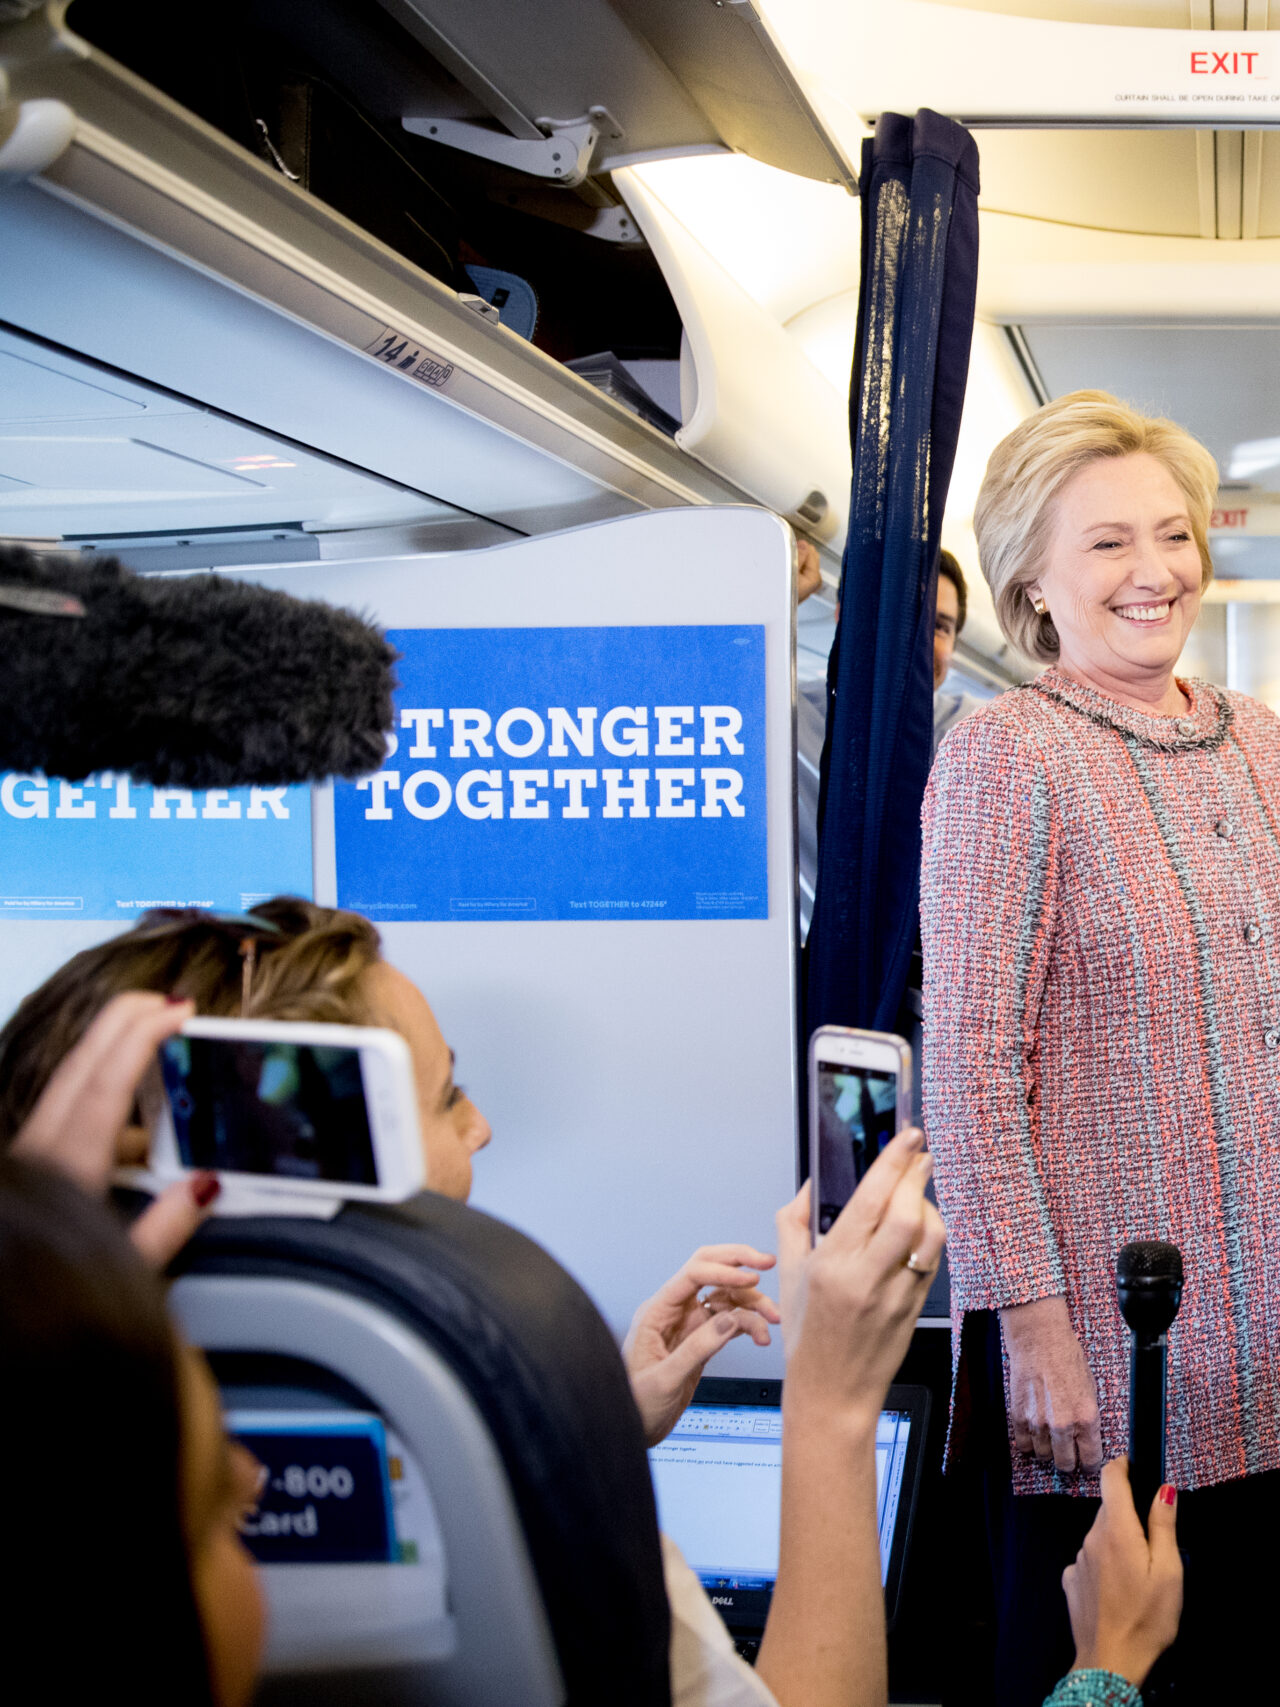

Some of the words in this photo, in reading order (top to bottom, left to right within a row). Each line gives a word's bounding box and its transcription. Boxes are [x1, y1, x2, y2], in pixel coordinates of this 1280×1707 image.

[1190, 51, 1260, 75] EXIT
[1114, 94, 1149, 102] CURTAIN
[1151, 94, 1176, 102] SHALL
[1179, 94, 1189, 102] BE
[1192, 94, 1214, 102] OPEN
[1216, 94, 1245, 102] DURING
[1248, 94, 1268, 102] TAKE
[374, 335, 408, 362] 14
[1210, 508, 1248, 528] EXIT
[356, 767, 746, 821] TOGETHER
[116, 900, 134, 908] Text
[135, 900, 177, 908] TOGETHER
[570, 900, 587, 909] Text
[589, 900, 630, 909] TOGETHER
[631, 900, 640, 909] to
[257, 1464, 355, 1498] -800
[711, 1596, 734, 1605] DELL
